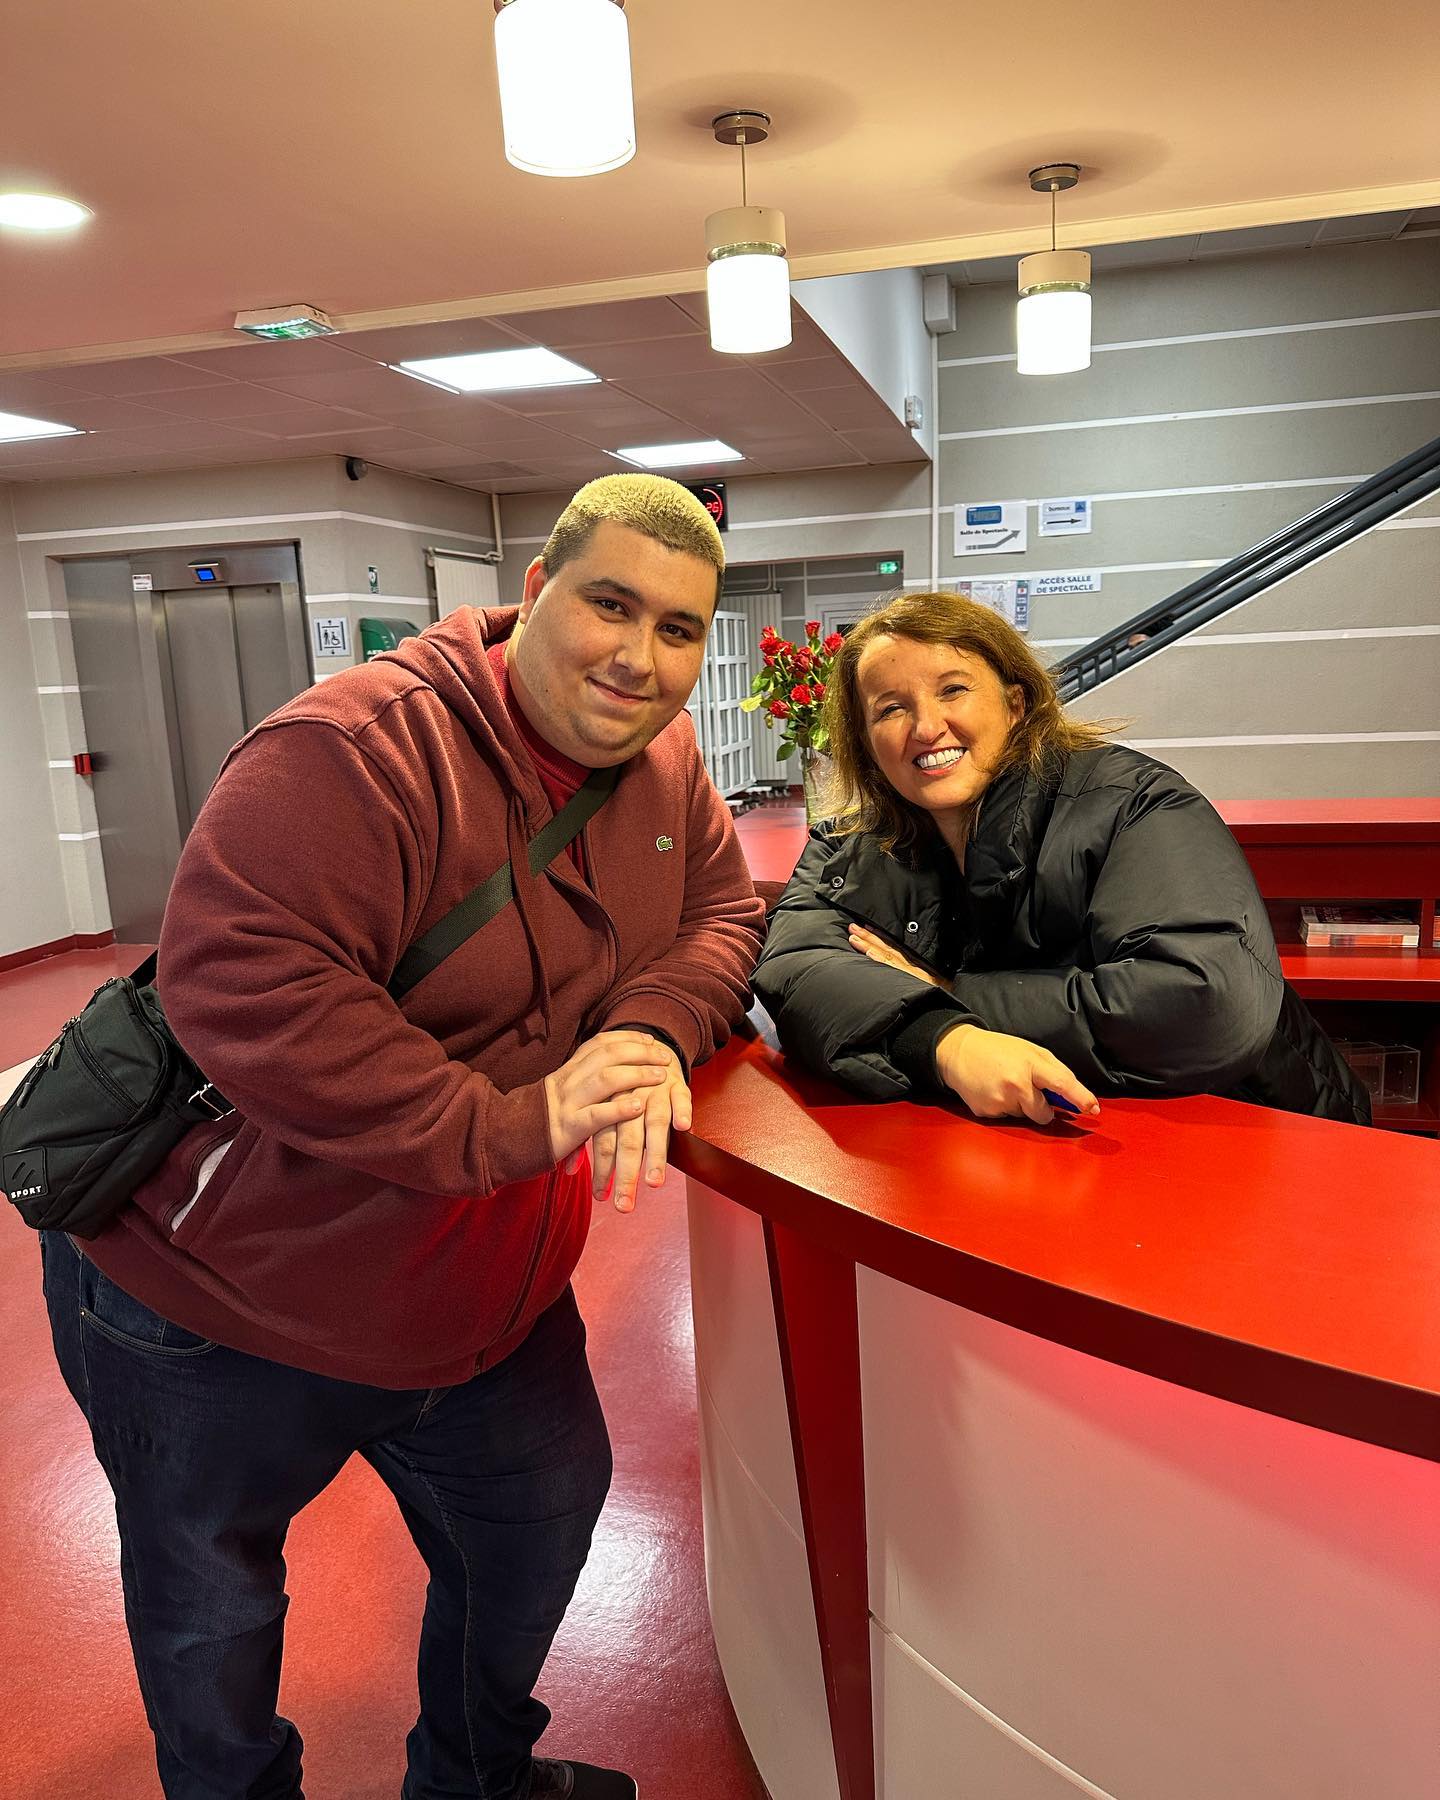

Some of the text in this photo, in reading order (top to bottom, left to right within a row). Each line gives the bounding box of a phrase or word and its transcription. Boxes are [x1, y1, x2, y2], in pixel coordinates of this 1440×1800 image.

[1039, 575, 1092, 585] ACCÈS SALLE
[1049, 584, 1094, 593] SPECTACLE
[11, 1185, 42, 1199] SPORT
